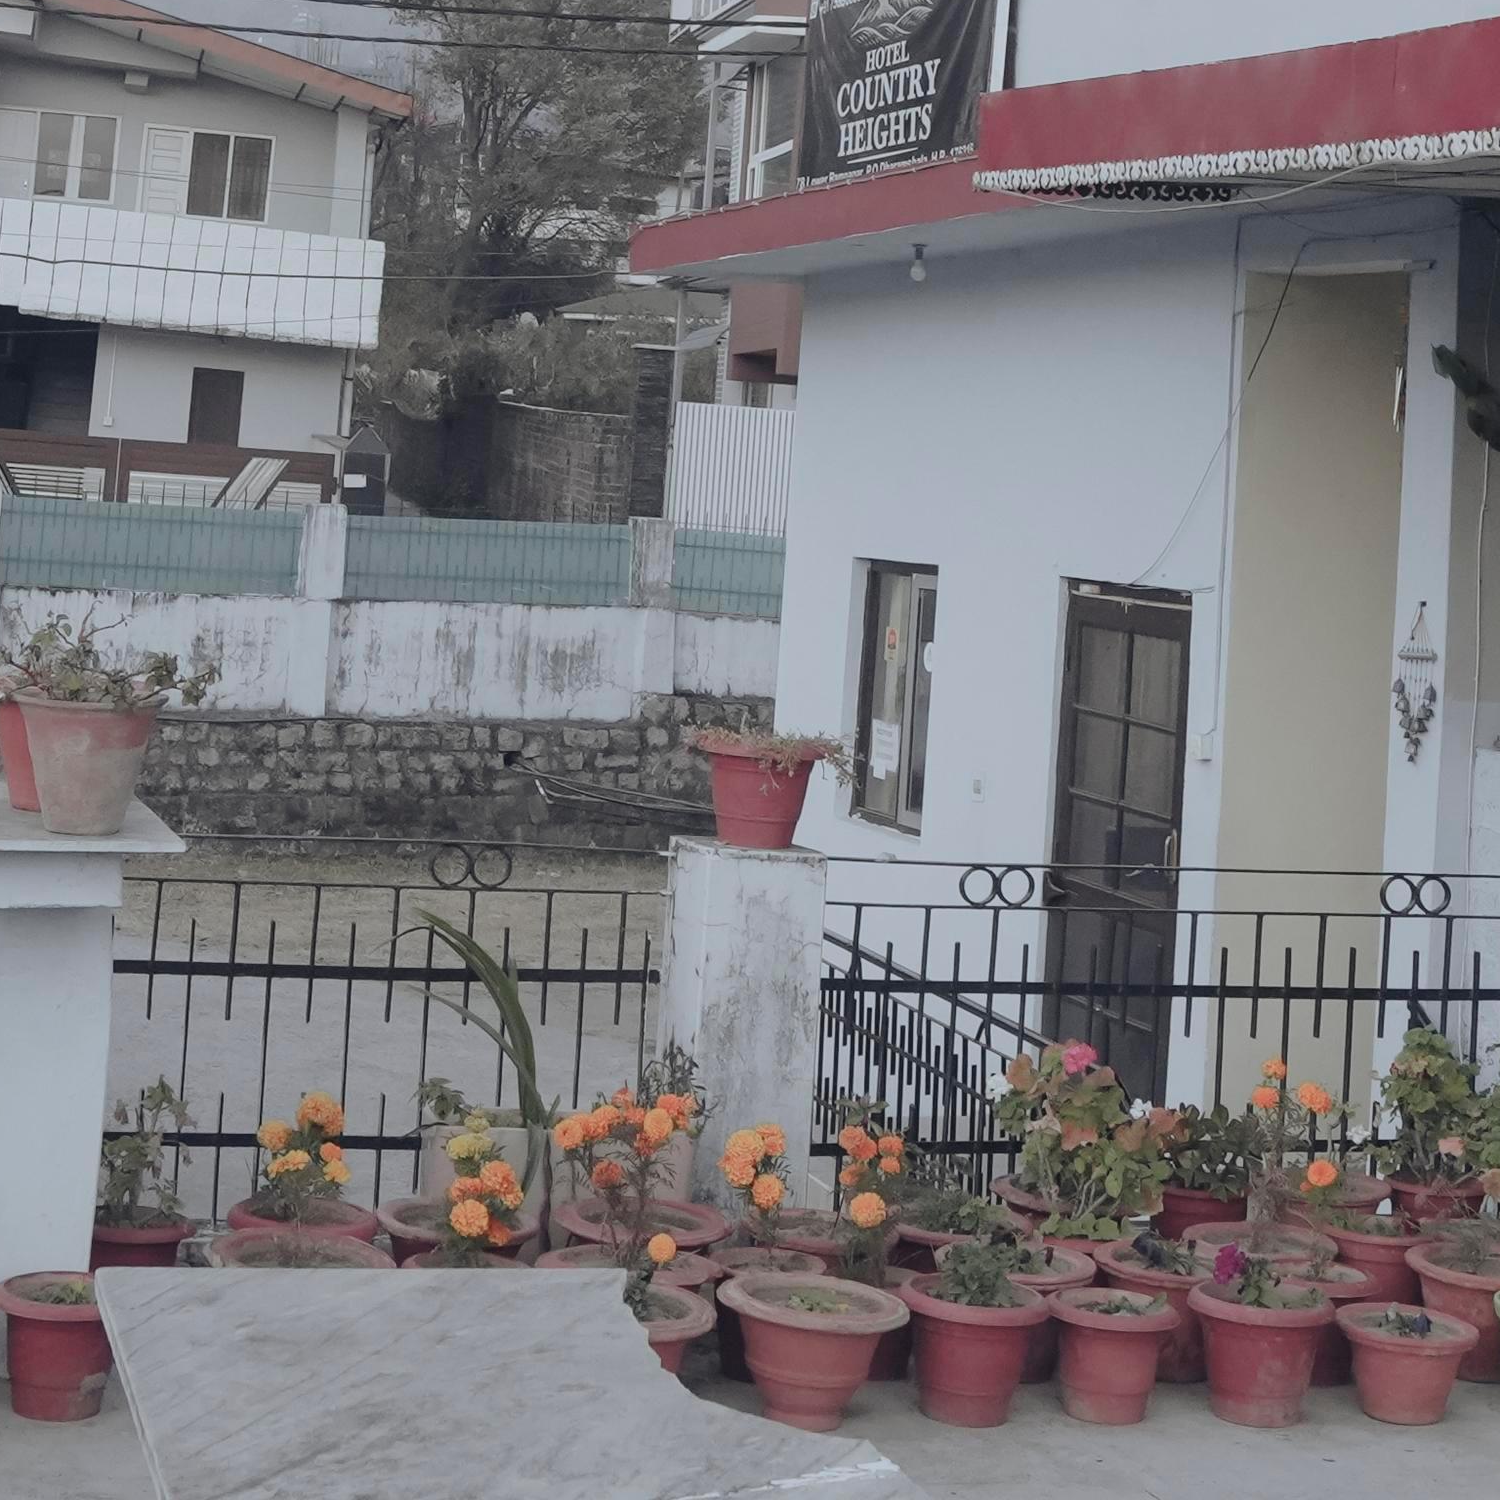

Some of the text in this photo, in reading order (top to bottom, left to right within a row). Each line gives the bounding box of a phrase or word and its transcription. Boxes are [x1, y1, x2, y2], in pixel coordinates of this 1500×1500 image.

[865, 40, 910, 72] HOTEL
[837, 58, 941, 117] COUNTRY
[838, 103, 933, 157] HEIGHTS
